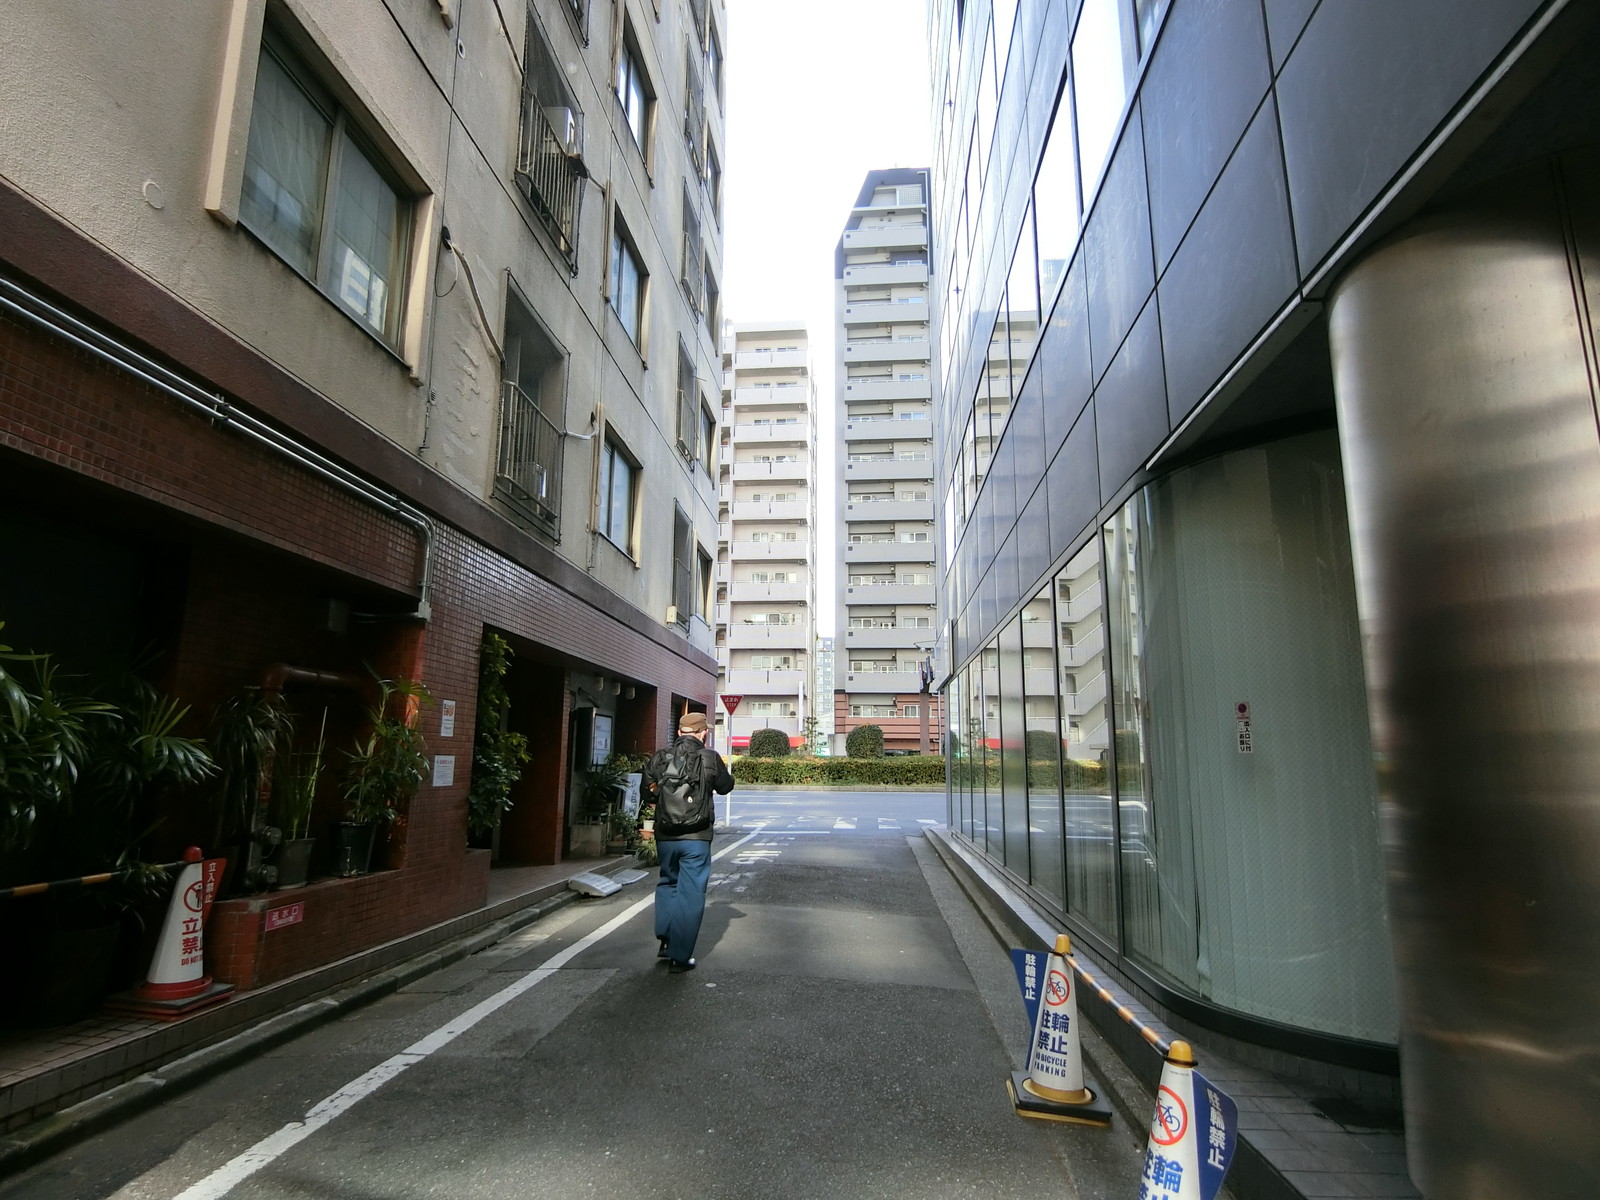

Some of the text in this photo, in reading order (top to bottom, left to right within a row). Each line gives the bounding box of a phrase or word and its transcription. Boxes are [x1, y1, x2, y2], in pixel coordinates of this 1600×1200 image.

[204, 862, 217, 904] 立入禁止
[1024, 953, 1037, 1001] 駐輪禁止
[1037, 1030, 1068, 1056] 禁止
[1041, 1053, 1067, 1068] BICYCLE
[1206, 1087, 1226, 1171] 駐輪禁止
